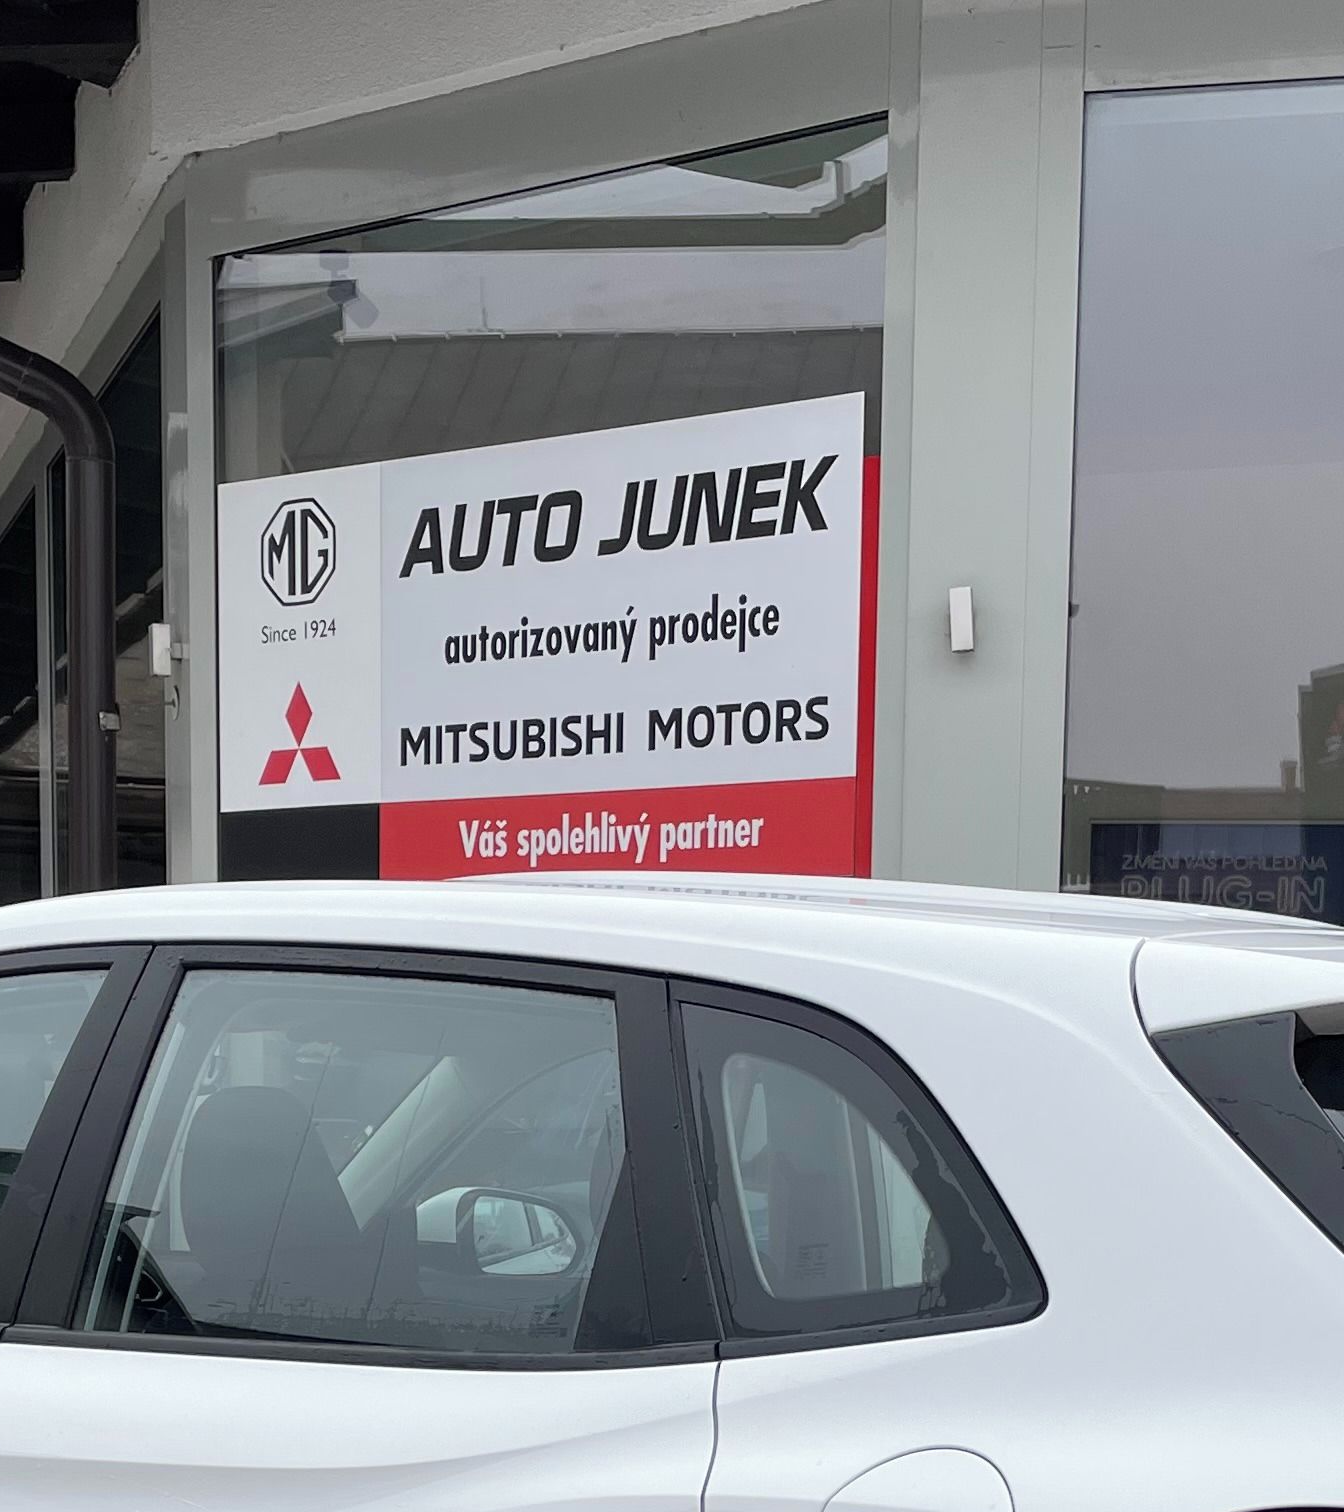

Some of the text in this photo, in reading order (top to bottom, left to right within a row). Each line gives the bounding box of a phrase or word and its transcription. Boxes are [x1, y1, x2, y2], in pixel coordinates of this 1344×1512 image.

[399, 454, 839, 579] AUTO JUNEK
[266, 506, 332, 598] MG
[260, 618, 337, 645] Since 1924
[444, 594, 781, 664] autorizovaný prodejce
[399, 696, 830, 767] MITSUBISHI MOTORS
[458, 812, 765, 867] Váš spolehlivý partner
[1300, 855, 1328, 872] NA
